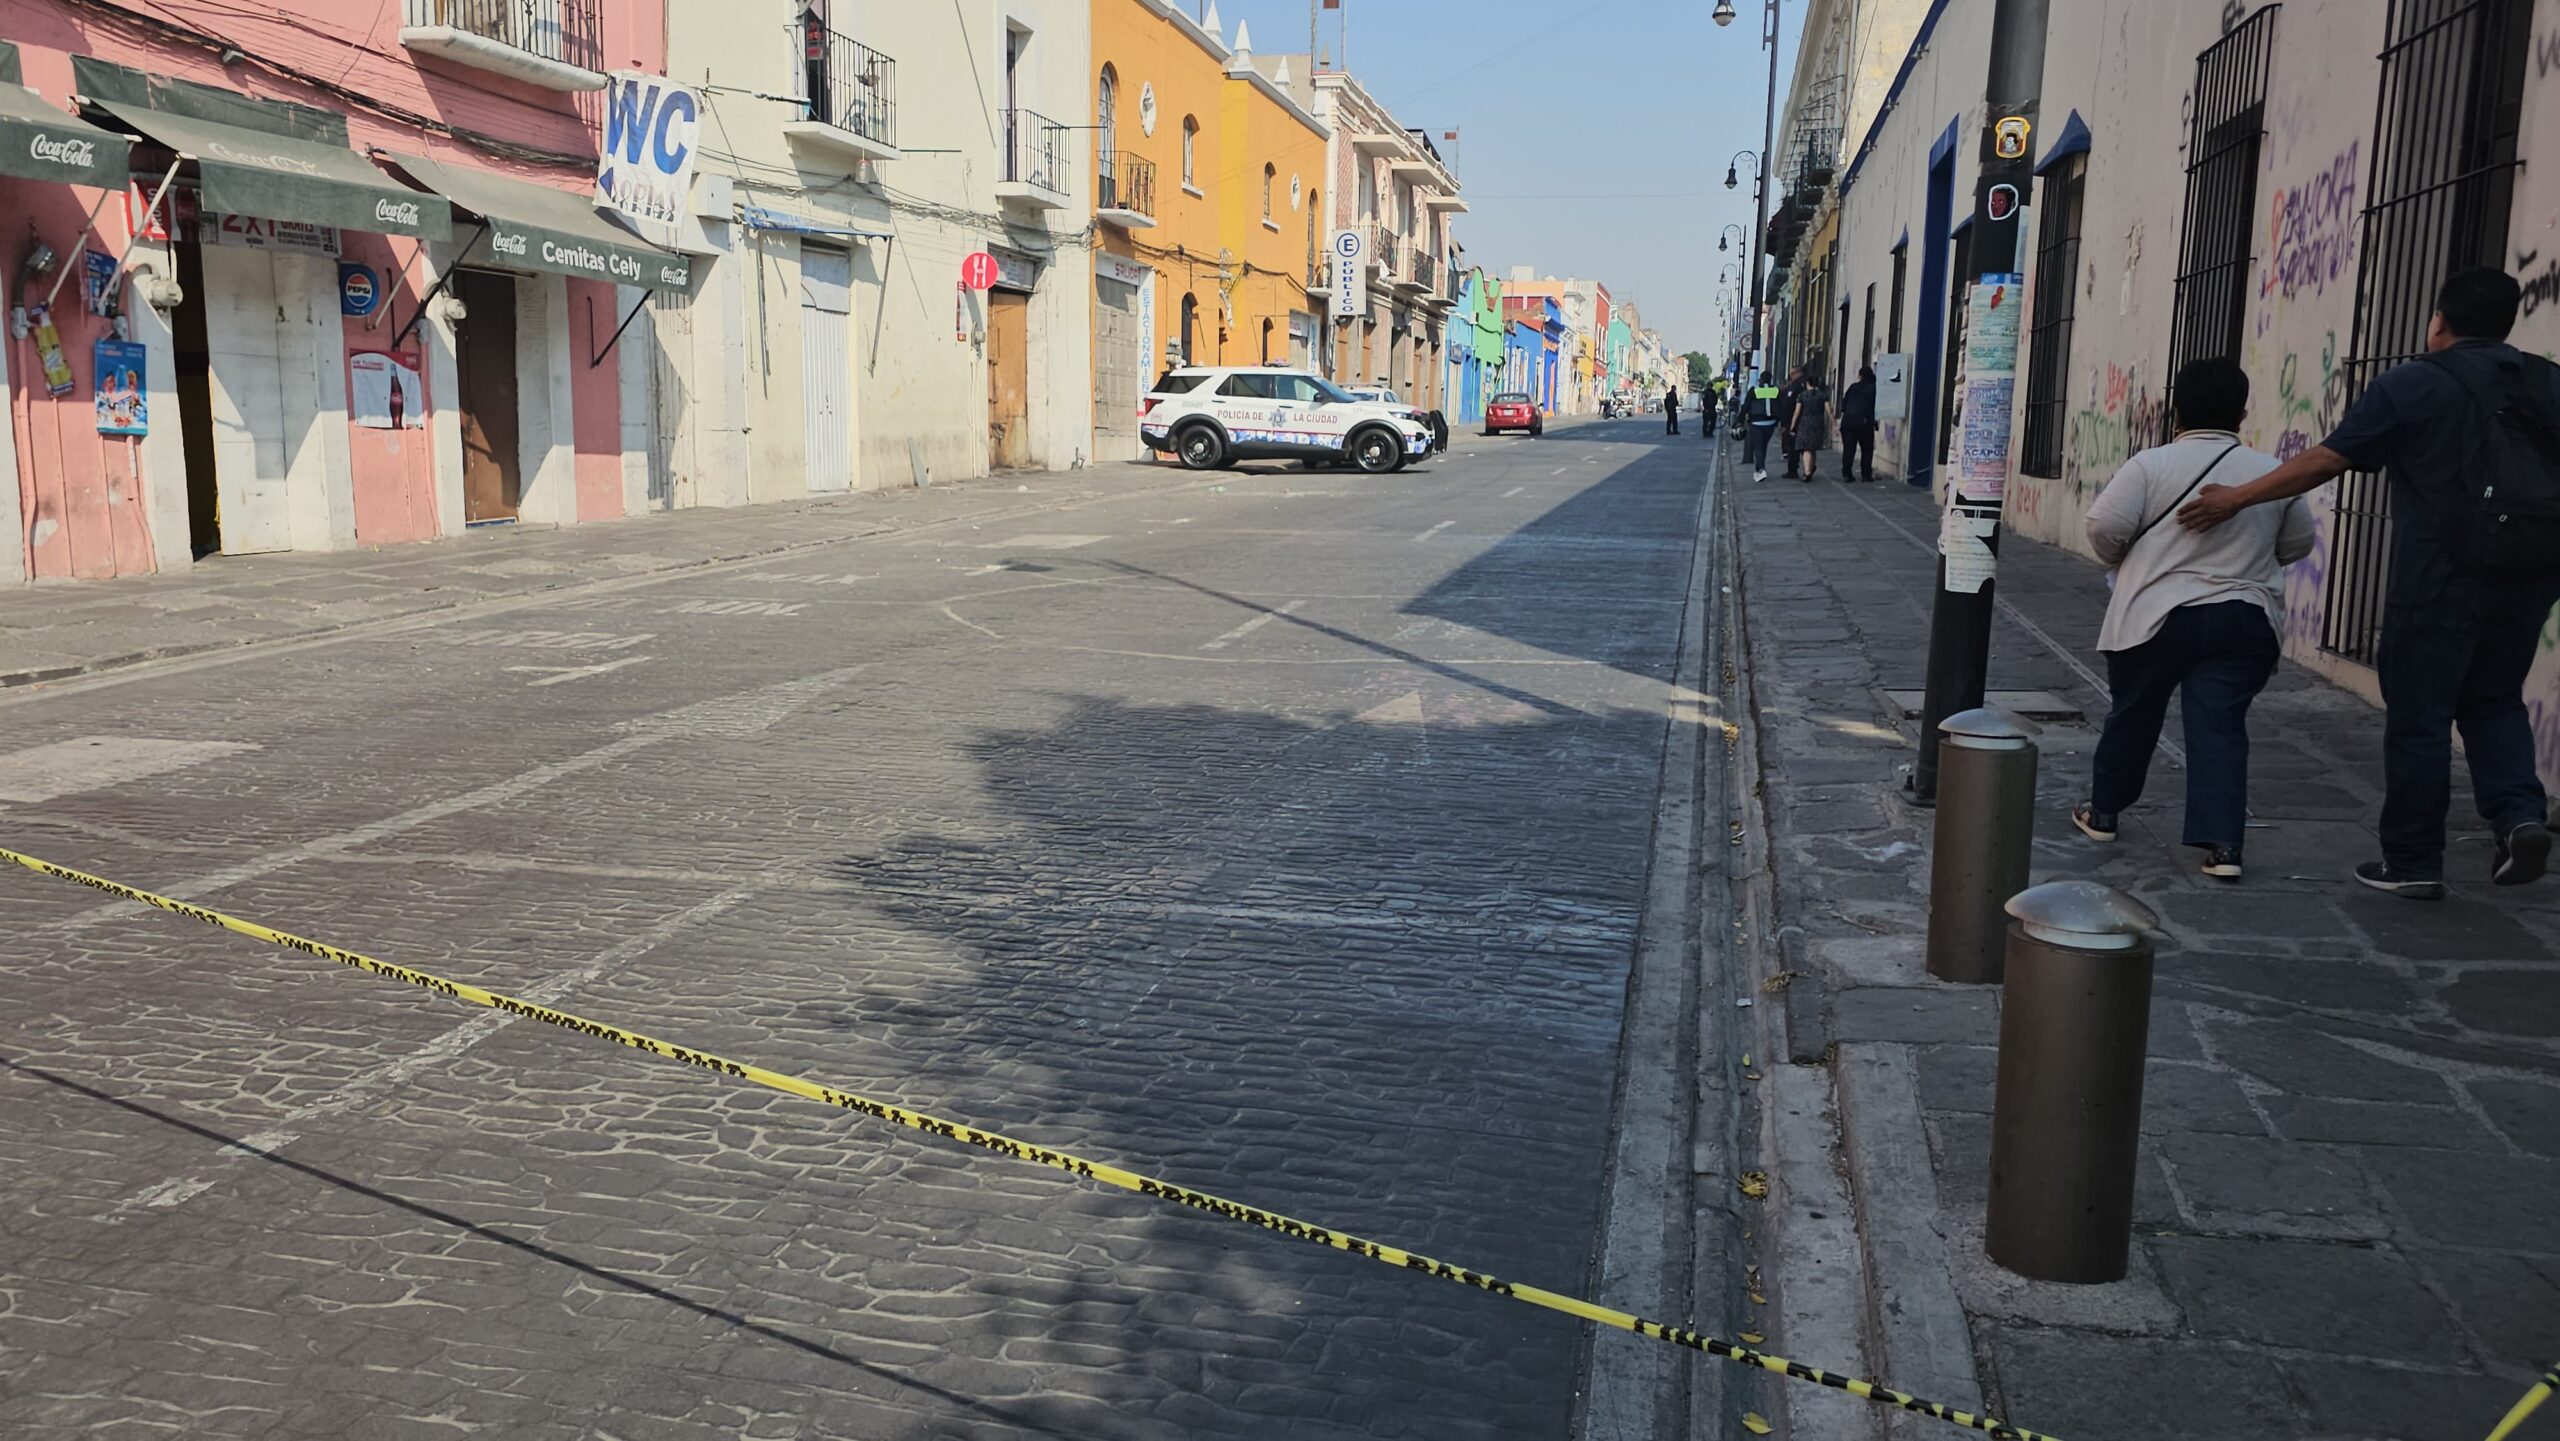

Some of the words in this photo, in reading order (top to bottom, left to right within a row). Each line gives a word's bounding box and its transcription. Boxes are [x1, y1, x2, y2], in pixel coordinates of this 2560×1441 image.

[608, 78, 696, 175] WC
[1343, 239, 1353, 251] E
[542, 241, 605, 272] Cemitas
[609, 254, 641, 281] Cely
[347, 284, 371, 295] PEPSI
[1253, 411, 1263, 420] DE
[1293, 414, 1304, 422] LA
[1306, 413, 1338, 424] CIUDAD
